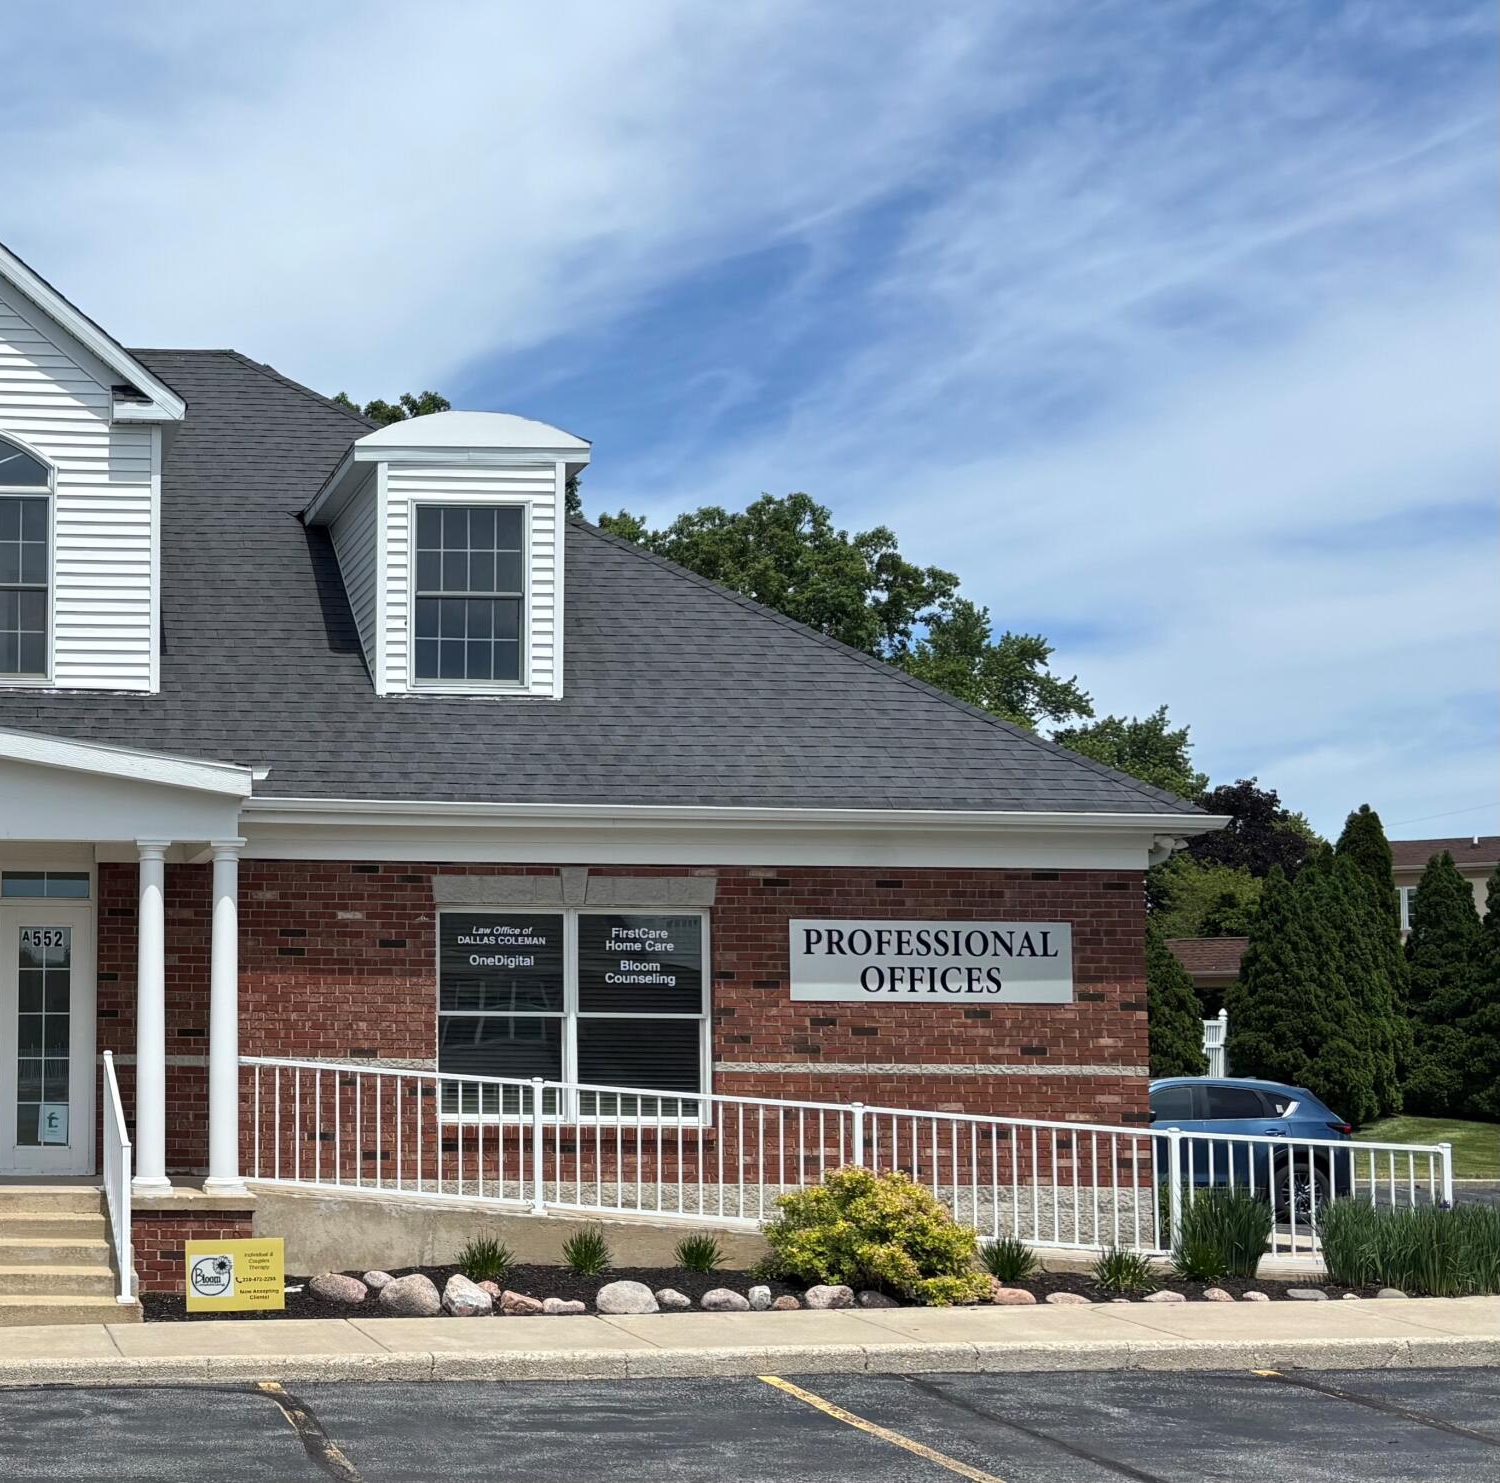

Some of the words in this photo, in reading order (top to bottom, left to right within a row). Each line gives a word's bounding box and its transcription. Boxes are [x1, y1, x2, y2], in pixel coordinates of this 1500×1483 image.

[472, 925, 492, 935] Law
[493, 926, 521, 935] Office
[522, 926, 533, 935] of
[611, 927, 669, 939] FirstCare
[22, 930, 30, 942] A
[33, 930, 63, 947] 552
[457, 935, 496, 945] DALLAS
[497, 936, 546, 945] COLEMAN
[605, 940, 642, 951] Home
[645, 940, 675, 952] Care
[803, 928, 1059, 958] PROFESSIONAL
[469, 954, 534, 969] OneDigital
[620, 960, 661, 971] Bloom
[605, 972, 676, 987] Counseling
[860, 965, 1002, 994] OFFICES
[195, 1267, 221, 1284] Bloom
